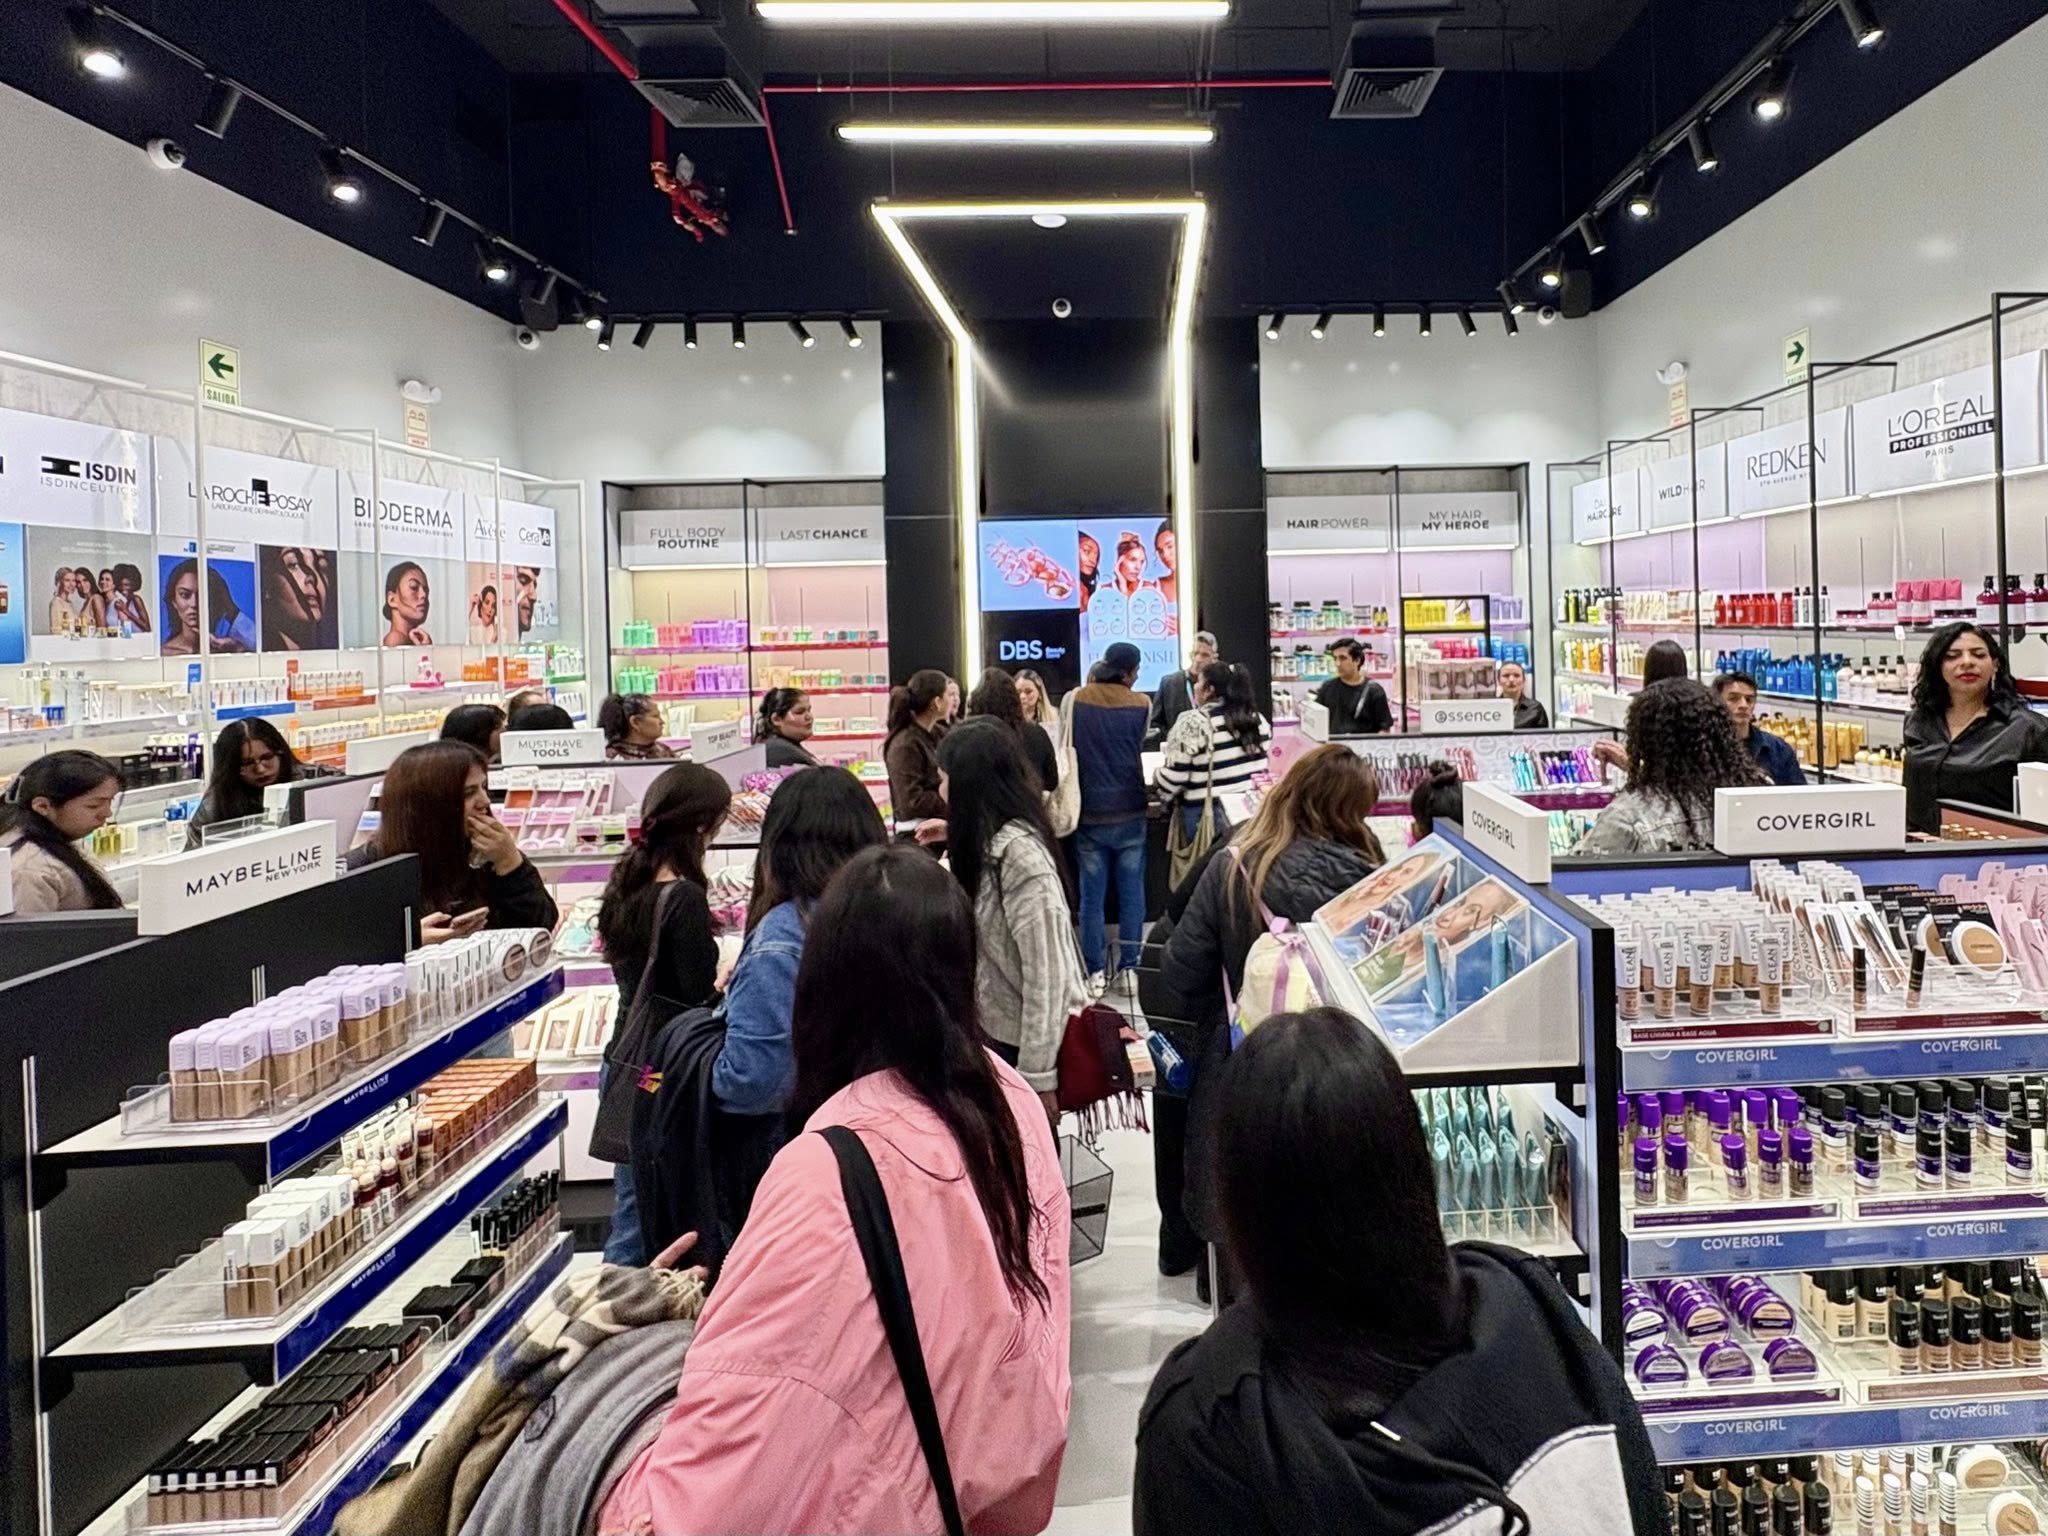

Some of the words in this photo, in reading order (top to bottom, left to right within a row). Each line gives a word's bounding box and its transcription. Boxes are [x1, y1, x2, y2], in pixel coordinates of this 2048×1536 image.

[206, 388, 236, 406] SALIDA
[1892, 421, 1993, 452] PROFESSIONNEL
[1747, 437, 1826, 480] REDKEN
[1925, 445, 1954, 458] PARIS
[86, 462, 136, 485] ISDIN
[40, 476, 138, 497] ISDINCEUTICS
[1429, 510, 1448, 520] MY
[1452, 509, 1482, 520] HAIR
[1287, 518, 1319, 529] HAIR
[1321, 517, 1369, 529] POWER
[1422, 521, 1442, 531] MY
[1445, 519, 1489, 531] HEROE
[650, 528, 683, 539] FULL
[687, 527, 726, 538] BODY
[780, 530, 811, 541] LAST
[812, 528, 868, 539] CHANCE
[658, 538, 719, 548] ROUTINE
[1000, 639, 1043, 660] DBS
[518, 739, 583, 749] MUST-HAVE
[532, 749, 570, 757] TOOLS
[1757, 811, 1876, 831] COVERGIRL
[1472, 810, 1515, 850] COVERGIRL
[186, 844, 322, 897] MAYBELLINE
[265, 870, 288, 883] NEW
[292, 860, 321, 875] YORK
[1720, 930, 1729, 962] CLEAN
[1663, 952, 1673, 985] CLEAN
[1768, 948, 1778, 980] CLEAN
[1921, 1039, 2001, 1053] COVERGIRL
[1695, 1048, 1778, 1063] COVERGIRL
[1926, 1222, 2006, 1237] COVERGIRL
[1701, 1235, 1783, 1250] COVERGIRL
[1929, 1404, 2009, 1419] COVERGIRL
[1704, 1419, 1787, 1435] COVERGIRL
